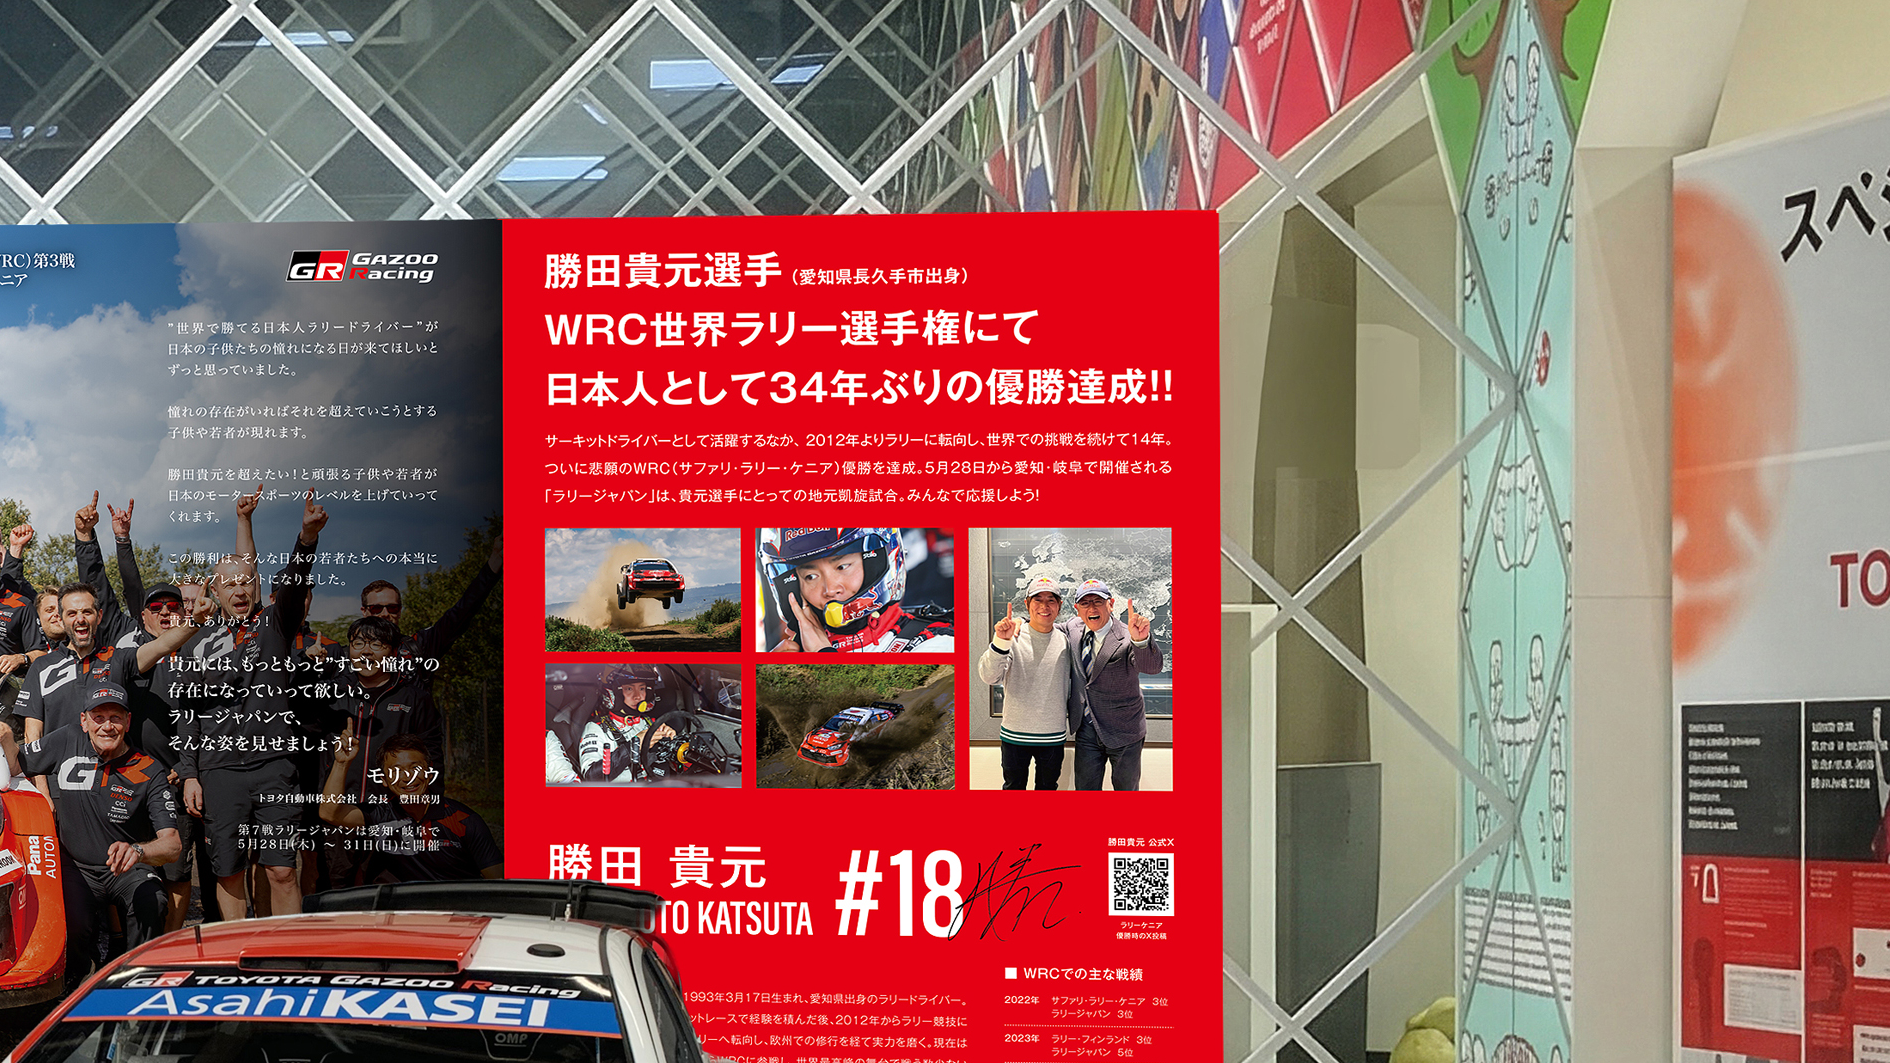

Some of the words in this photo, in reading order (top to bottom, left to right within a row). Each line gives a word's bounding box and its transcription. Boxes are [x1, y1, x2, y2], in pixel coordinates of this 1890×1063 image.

[1781, 168, 1890, 263] スペ
[290, 262, 344, 280] GR
[351, 253, 439, 265] GAZOO
[545, 252, 782, 289] 勝田貴元選手
[791, 266, 970, 287] (愛知県長久手市出身)
[348, 267, 435, 284] Racing
[545, 309, 1039, 347] WRC世界ラリー選手権にて
[168, 342, 439, 356] 日本の子供たちの憧れになる日が来てほしいと
[168, 363, 298, 377] ずっと思っていました。
[546, 368, 1174, 406] 日本人として34年ぶりの優勝達成!!
[168, 404, 438, 418] 憧れの存在がいればそれを超えていこうとする
[168, 426, 308, 440] 子供や若者が現れます。
[168, 467, 438, 481] 勝田貴元を超えたい!と頑張る子供や若者が
[168, 488, 438, 502] 日本のモータースポーツのレベルを上げていって
[168, 510, 221, 524] くれます。
[168, 551, 439, 566] この勝利は、そんな日本の若者たちへの本当に
[168, 573, 347, 587] 大きなプレゼントになりました。
[168, 614, 269, 629] 貴元、ありがとう!
[168, 682, 371, 700] 存在になっていって欲しい。
[168, 709, 302, 726] ラリージャパンで、
[168, 735, 353, 752] そんな姿を見せましょう!
[367, 766, 440, 786] モリゾウ
[259, 793, 357, 805] トヨタ自動車株式会社
[367, 794, 388, 805] 会長
[398, 794, 440, 805] 豊田章男
[237, 838, 316, 851] 5月28日(木)
[1108, 837, 1146, 847] 勝田貴元
[1148, 837, 1175, 847] 公式X
[550, 843, 641, 887] 勝田
[669, 844, 767, 889] 貴元
[835, 849, 964, 938] #18
[698, 901, 814, 935] KATSUTA
[1120, 921, 1163, 929] ラリーケニア
[1116, 931, 1168, 941] 優勝時のX投稿
[1023, 966, 1144, 982] WRCでの主な戦績
[194, 974, 321, 986] TOYOTA
[329, 974, 455, 989] GAZOO
[461, 979, 582, 999] Racing
[127, 988, 550, 1028] AsahiKASEI
[1004, 995, 1040, 1005] 2022年
[1051, 996, 1146, 1007] サファリ・ラリー・ケニア
[1152, 997, 1169, 1007] 3位
[1051, 1009, 1111, 1018] ラリージャパン
[1117, 1010, 1134, 1019] 3位
[495, 1032, 528, 1045] OMP
[1004, 1034, 1040, 1043] 2023年
[1051, 1035, 1130, 1044] ラリー・フィンランド
[1136, 1035, 1153, 1044] 3位
[1051, 1048, 1111, 1057] ラリージャパン
[1117, 1048, 1134, 1057] 5位
